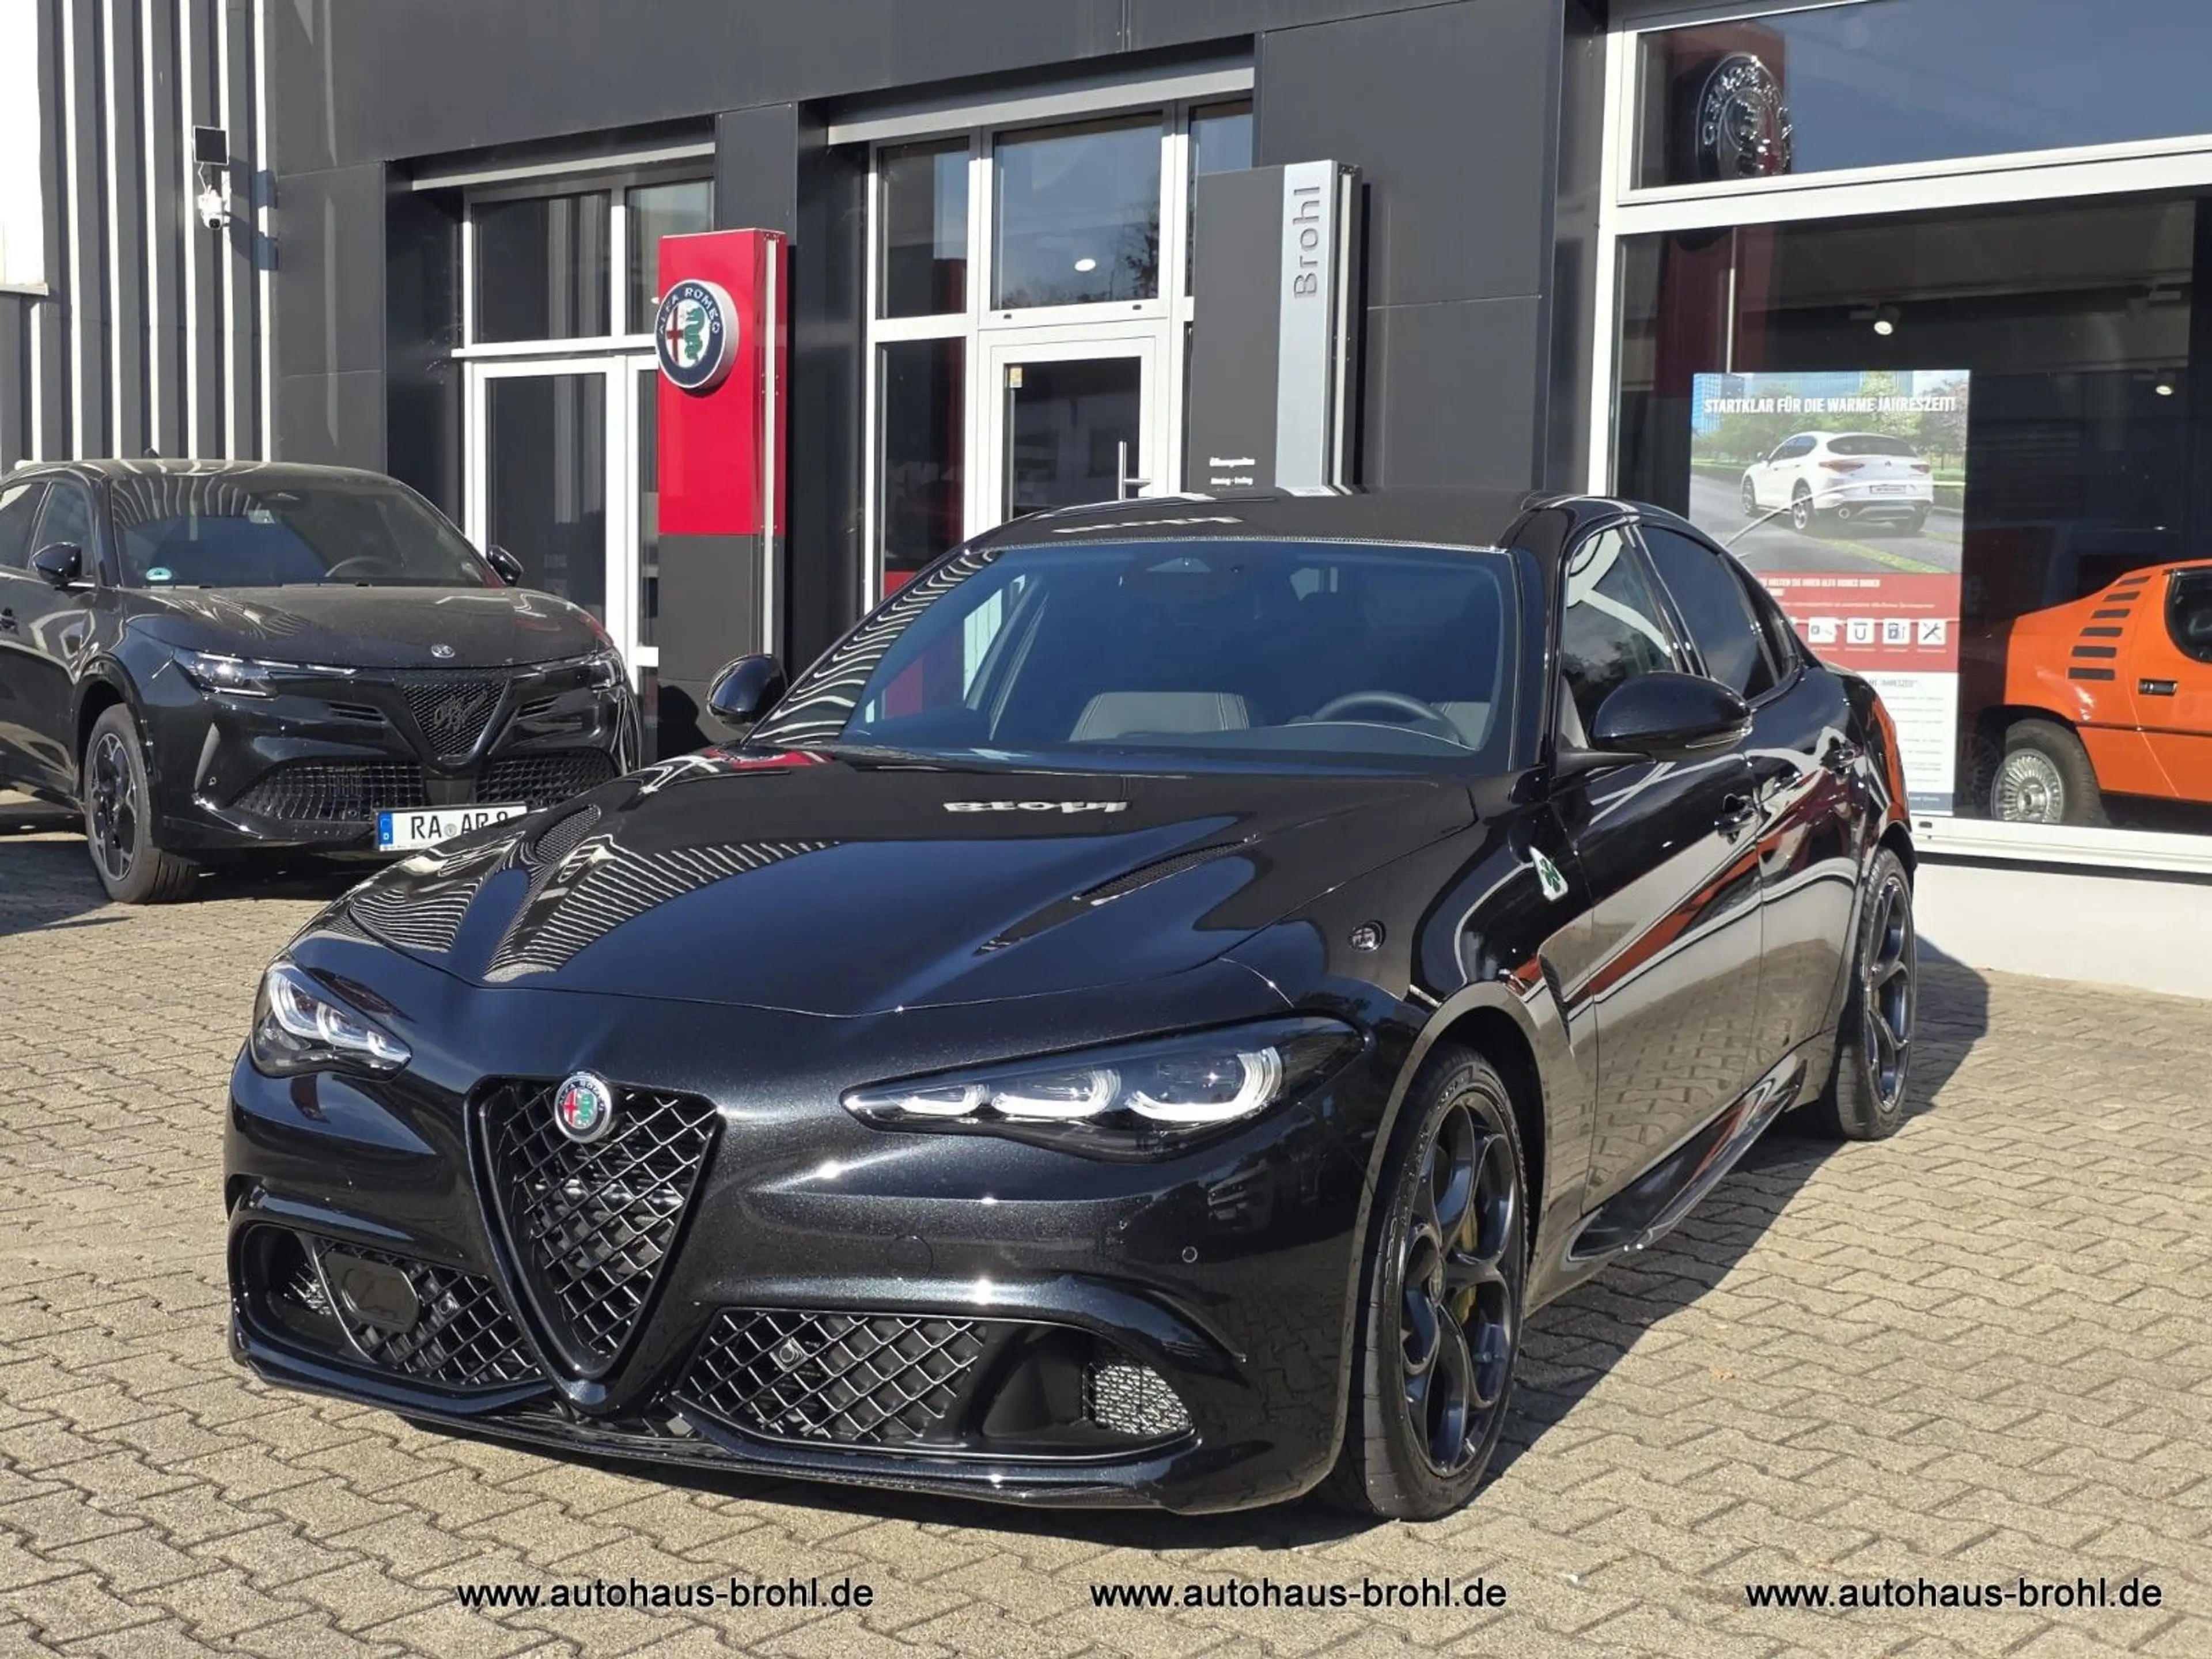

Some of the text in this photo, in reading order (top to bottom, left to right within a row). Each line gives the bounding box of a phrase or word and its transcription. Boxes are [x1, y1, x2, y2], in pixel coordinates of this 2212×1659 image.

[1293, 186, 1320, 299] Brohl
[684, 287, 721, 334] ROMEO
[1703, 398, 1774, 413] STARTKLAR
[1777, 395, 1801, 413] FÜR
[1804, 398, 1825, 412] DIE
[1828, 397, 1876, 412] WARME
[411, 815, 442, 839] RA
